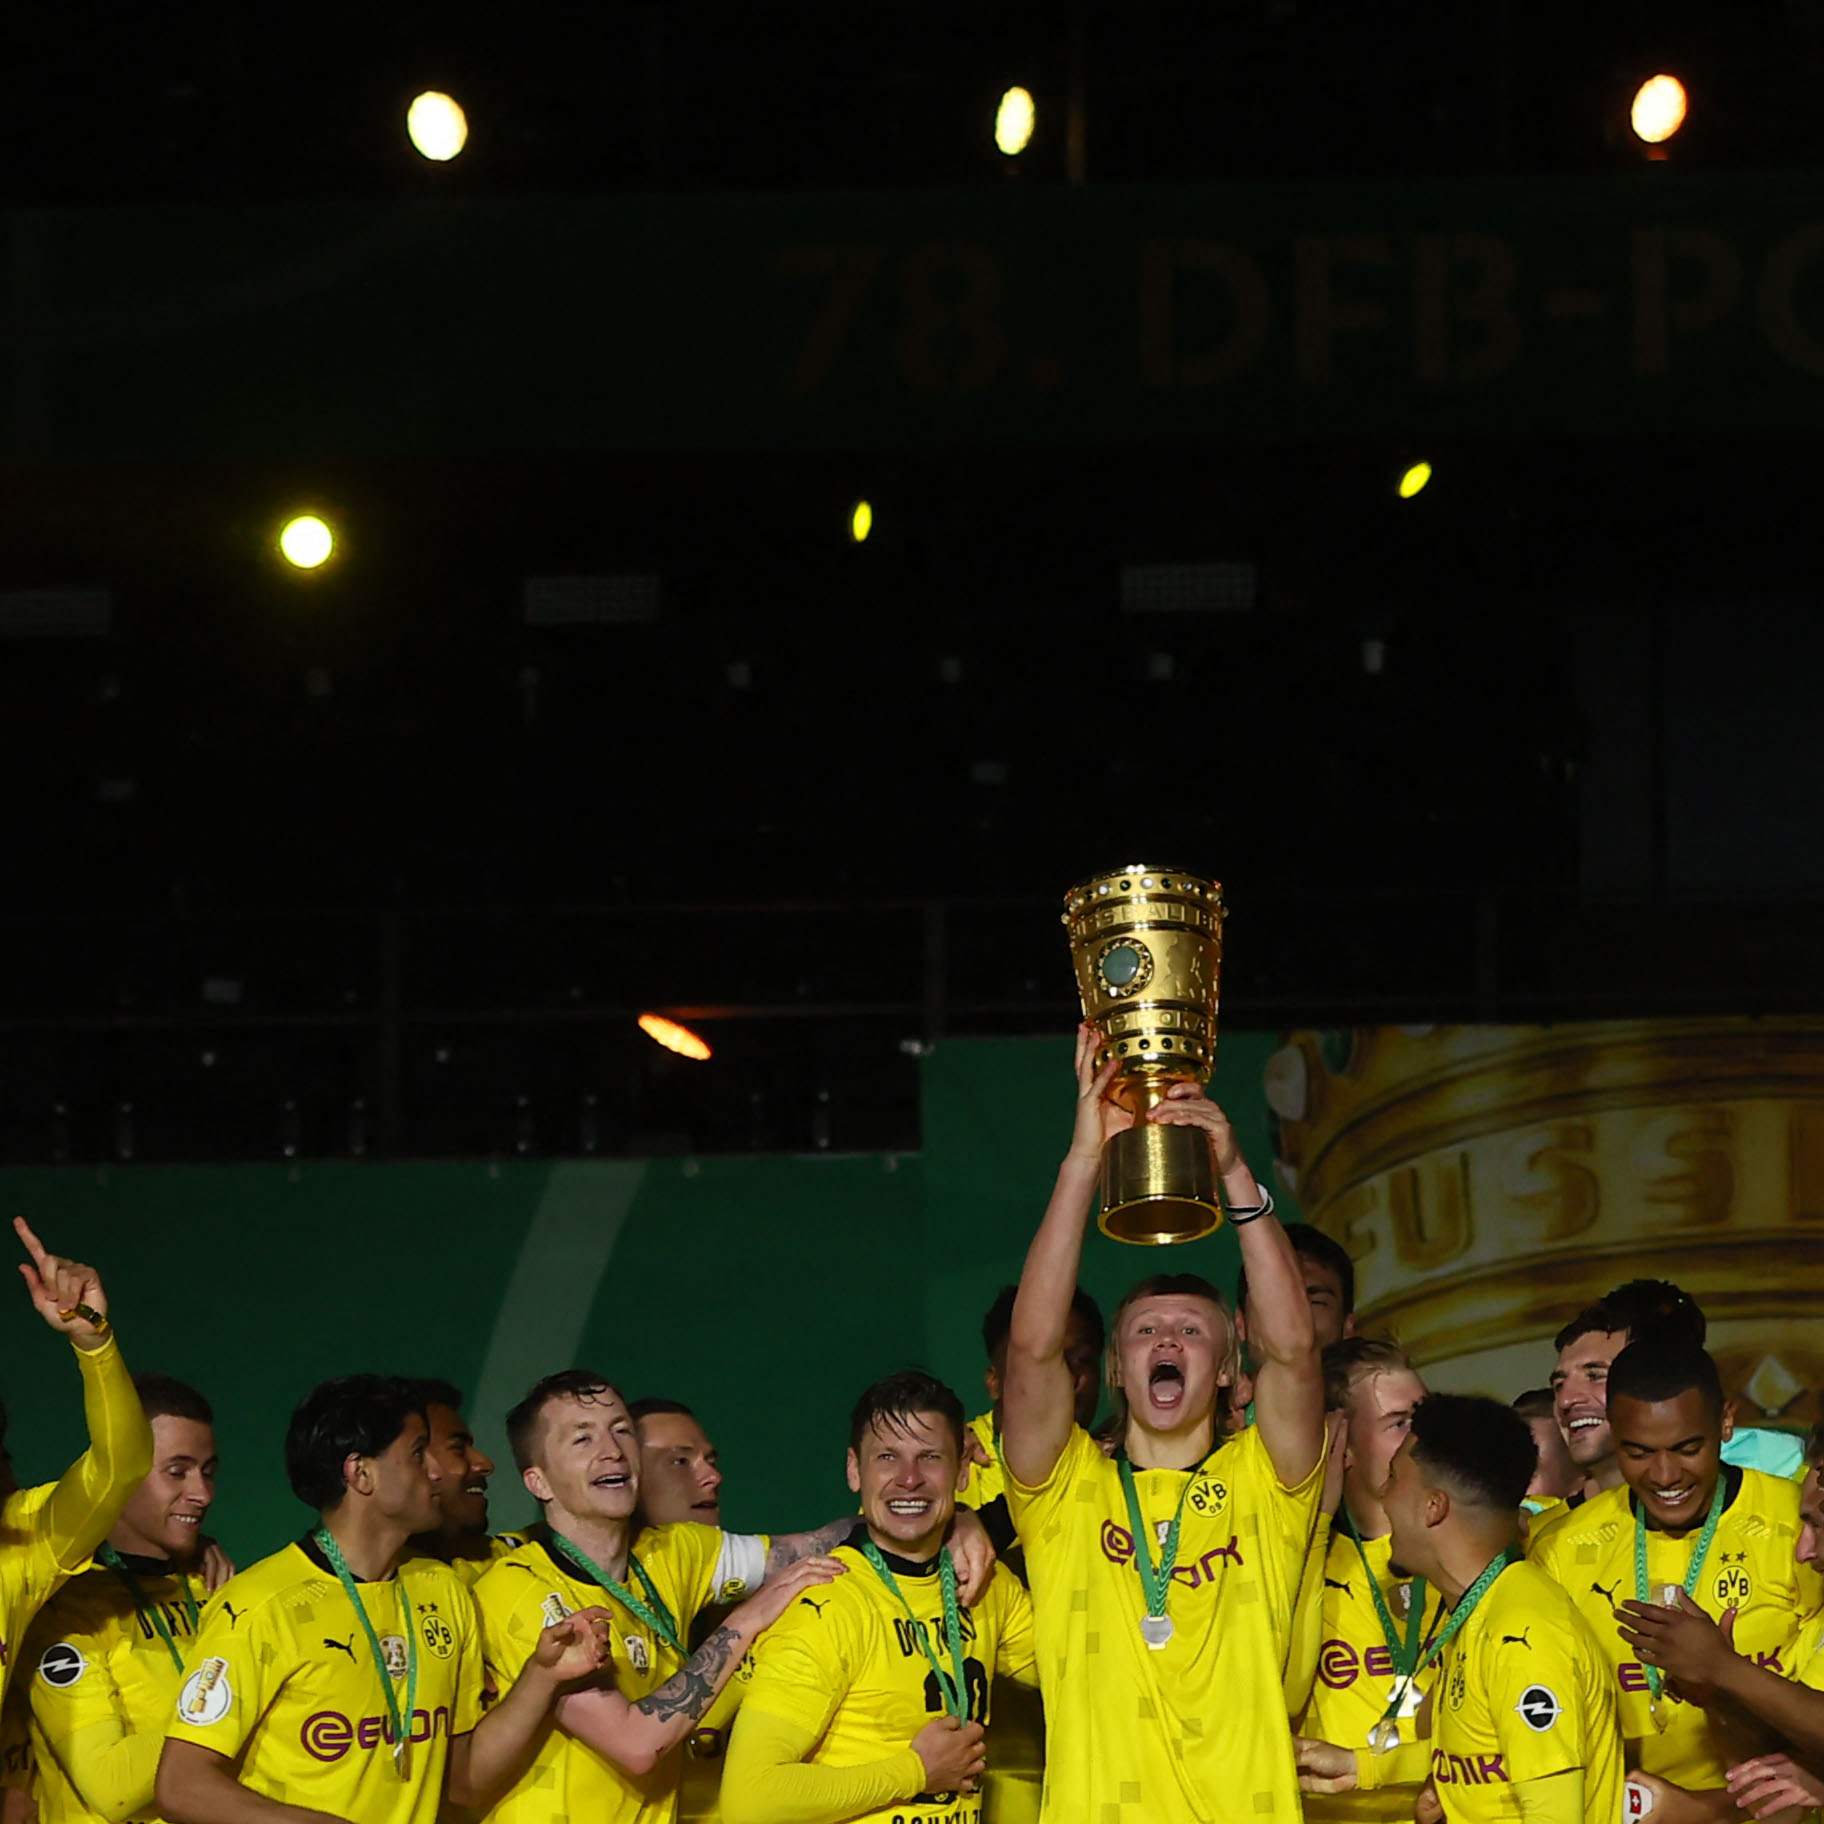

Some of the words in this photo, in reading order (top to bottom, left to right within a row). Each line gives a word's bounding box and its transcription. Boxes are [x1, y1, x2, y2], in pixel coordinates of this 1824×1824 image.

[781, 241, 1064, 392] 78.
[1191, 1481, 1227, 1511] BVB
[1718, 1569, 1749, 1598] BVB
